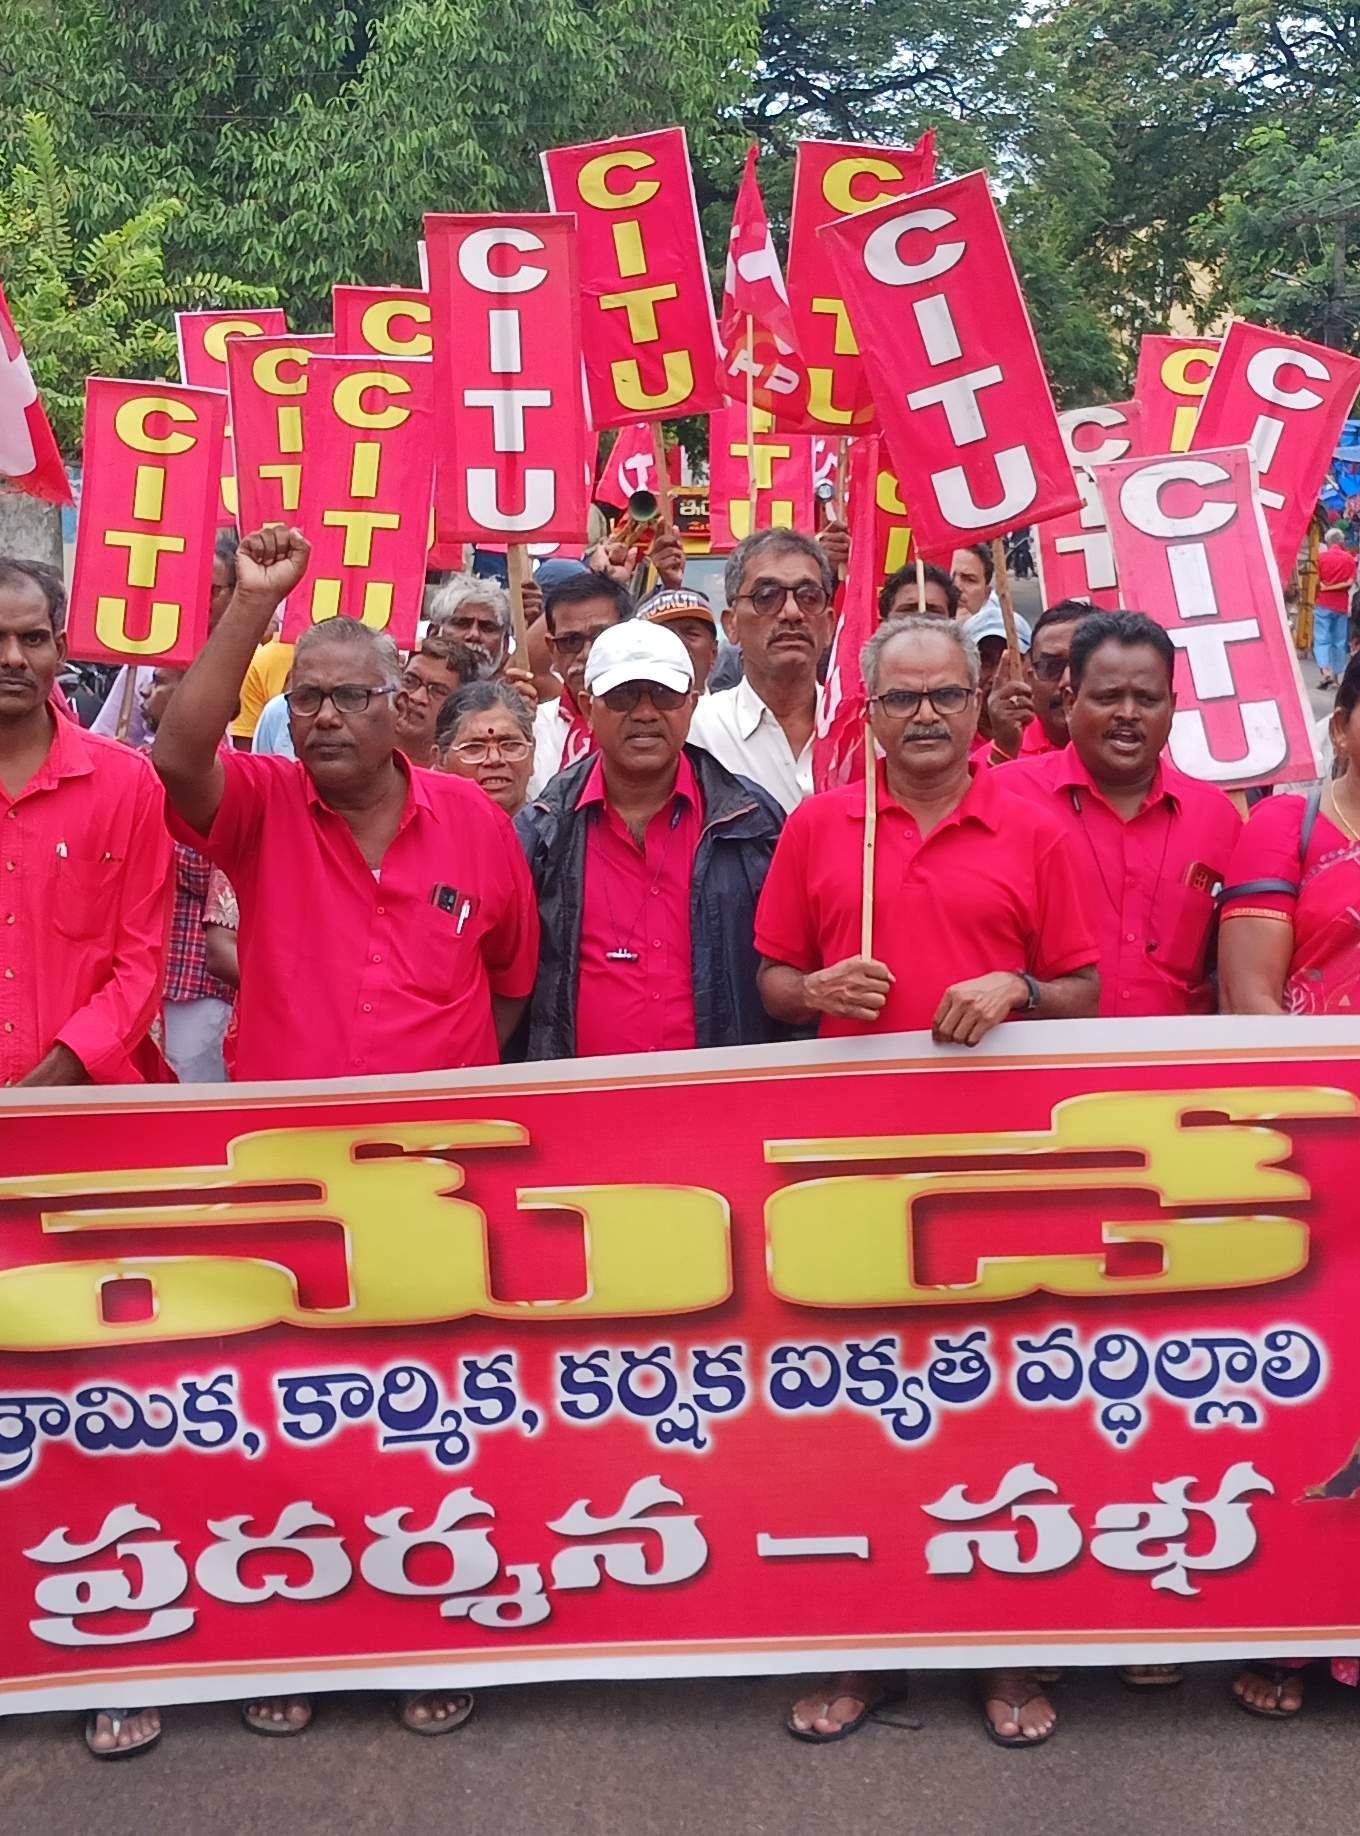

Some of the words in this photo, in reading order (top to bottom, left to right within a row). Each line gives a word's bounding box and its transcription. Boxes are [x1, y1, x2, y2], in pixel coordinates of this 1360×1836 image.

[457, 227, 557, 532] CITU
[576, 149, 696, 411] CITU
[863, 207, 1037, 530] CITU
[95, 396, 198, 655] CITU
[252, 347, 313, 528] CIT
[310, 371, 413, 632] CITU
[1120, 461, 1287, 781] CITU
[277, 1354, 538, 1464] కార్మిక,
[559, 1345, 746, 1450] కర్షక
[770, 1331, 992, 1441] ఐక్యత
[22, 1474, 709, 1647] ప్రదర్శన
[919, 1461, 1275, 1597] సభ
